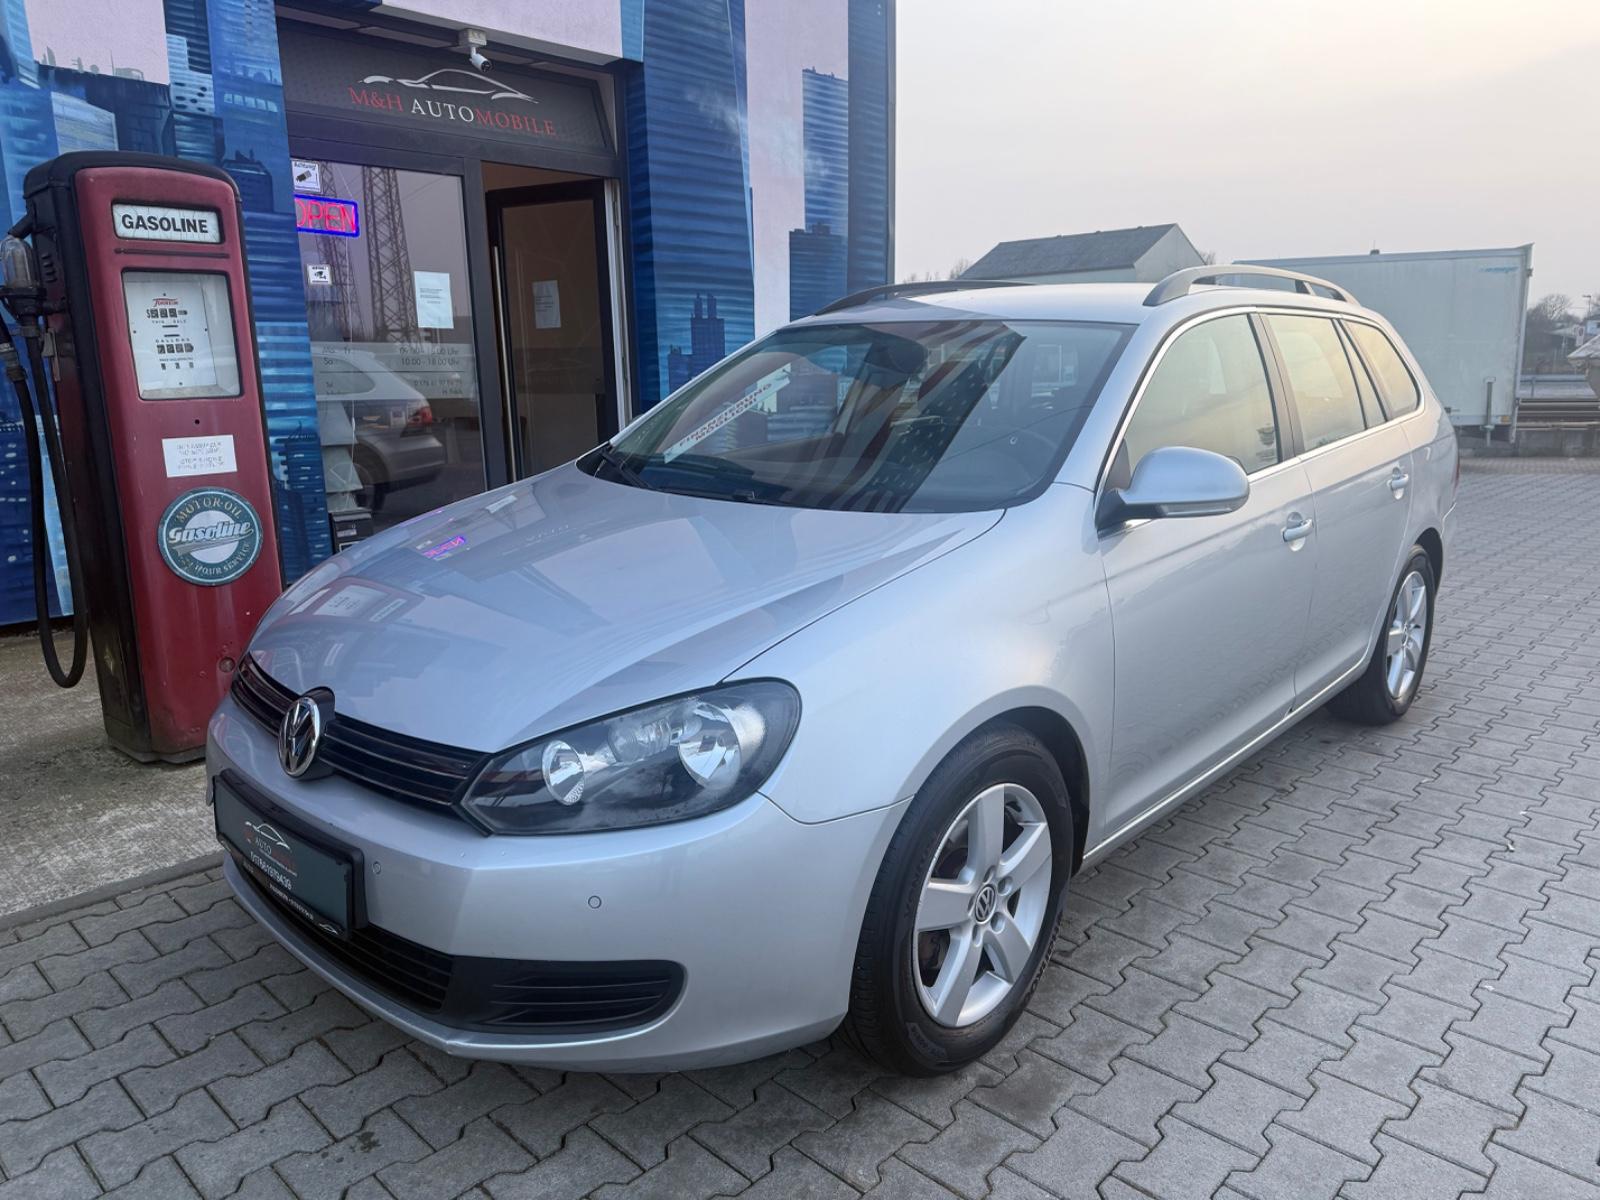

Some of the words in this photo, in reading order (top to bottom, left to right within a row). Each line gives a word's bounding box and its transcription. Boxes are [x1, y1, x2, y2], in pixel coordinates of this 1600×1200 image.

[348, 87, 403, 113] M&H
[411, 98, 557, 137] AUTOMOBILE
[121, 213, 209, 234] GASOLINE
[168, 520, 251, 543] Gasoline
